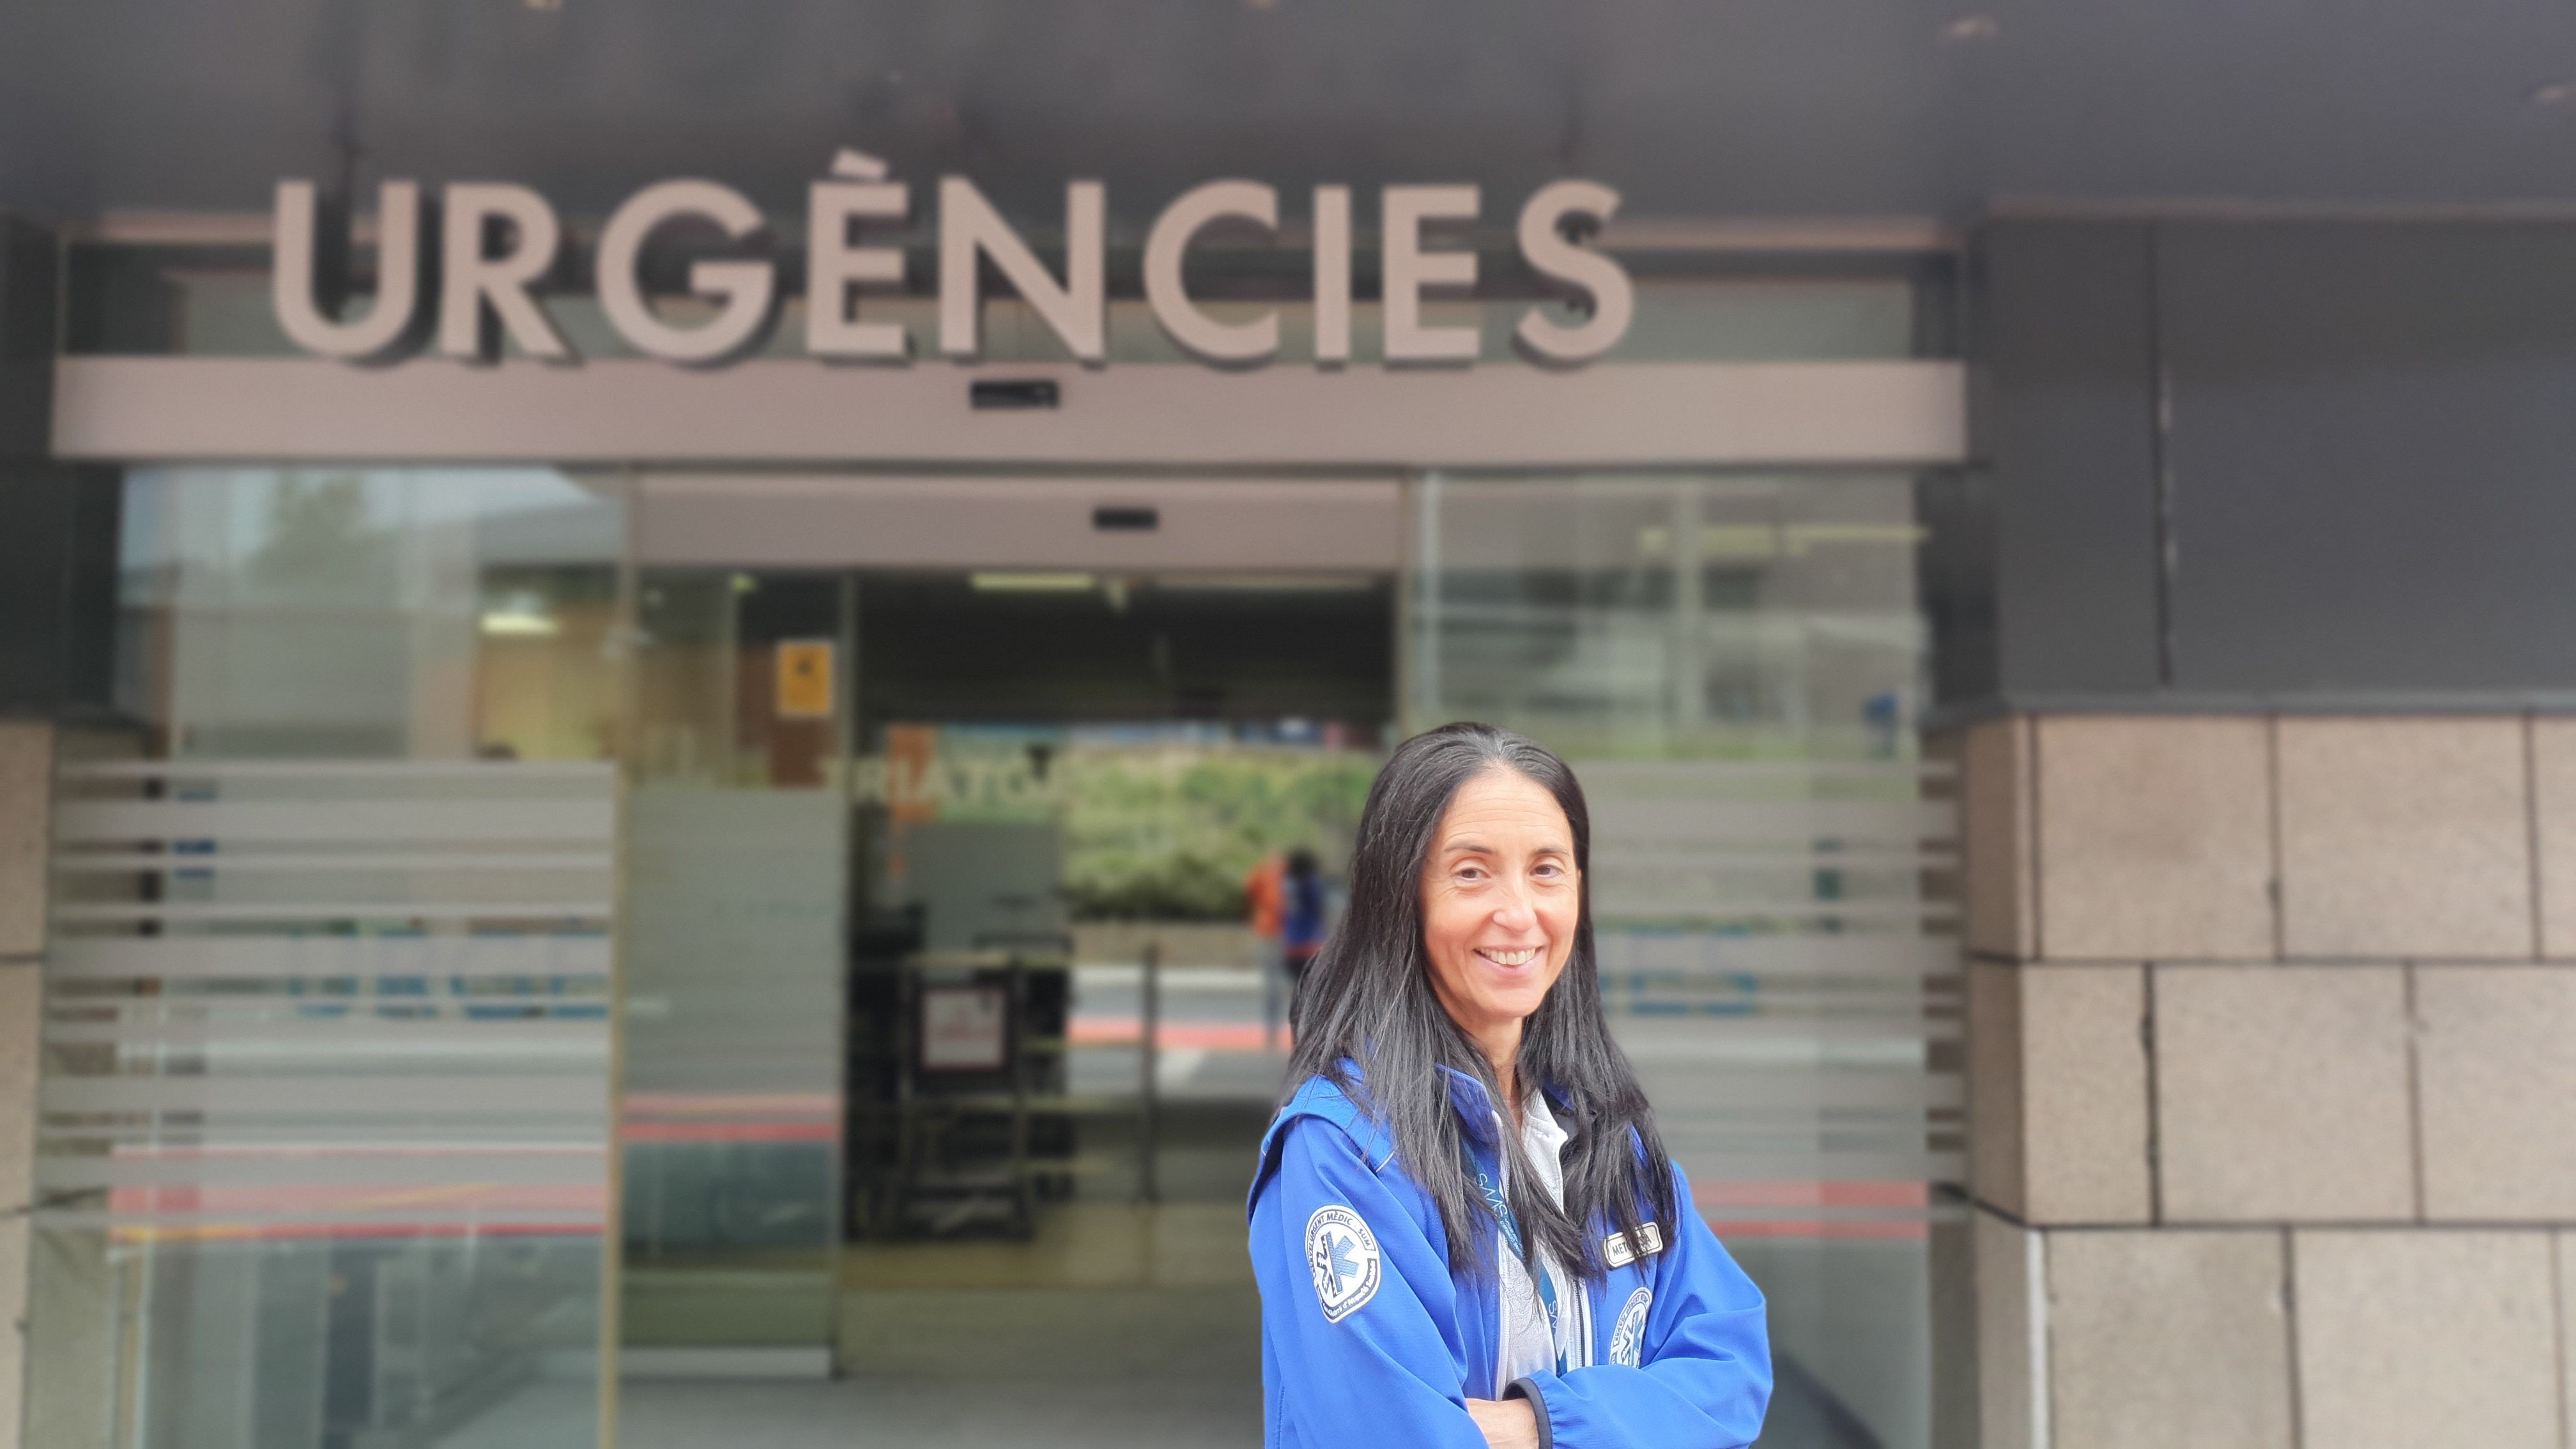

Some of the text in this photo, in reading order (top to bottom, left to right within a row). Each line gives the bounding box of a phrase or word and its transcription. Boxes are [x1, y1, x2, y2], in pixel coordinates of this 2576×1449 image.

[272, 149, 1635, 363] URGÈNCIES
[1326, 1211, 1353, 1225] MÈDIC
[1357, 1228, 1371, 1246] SUM
